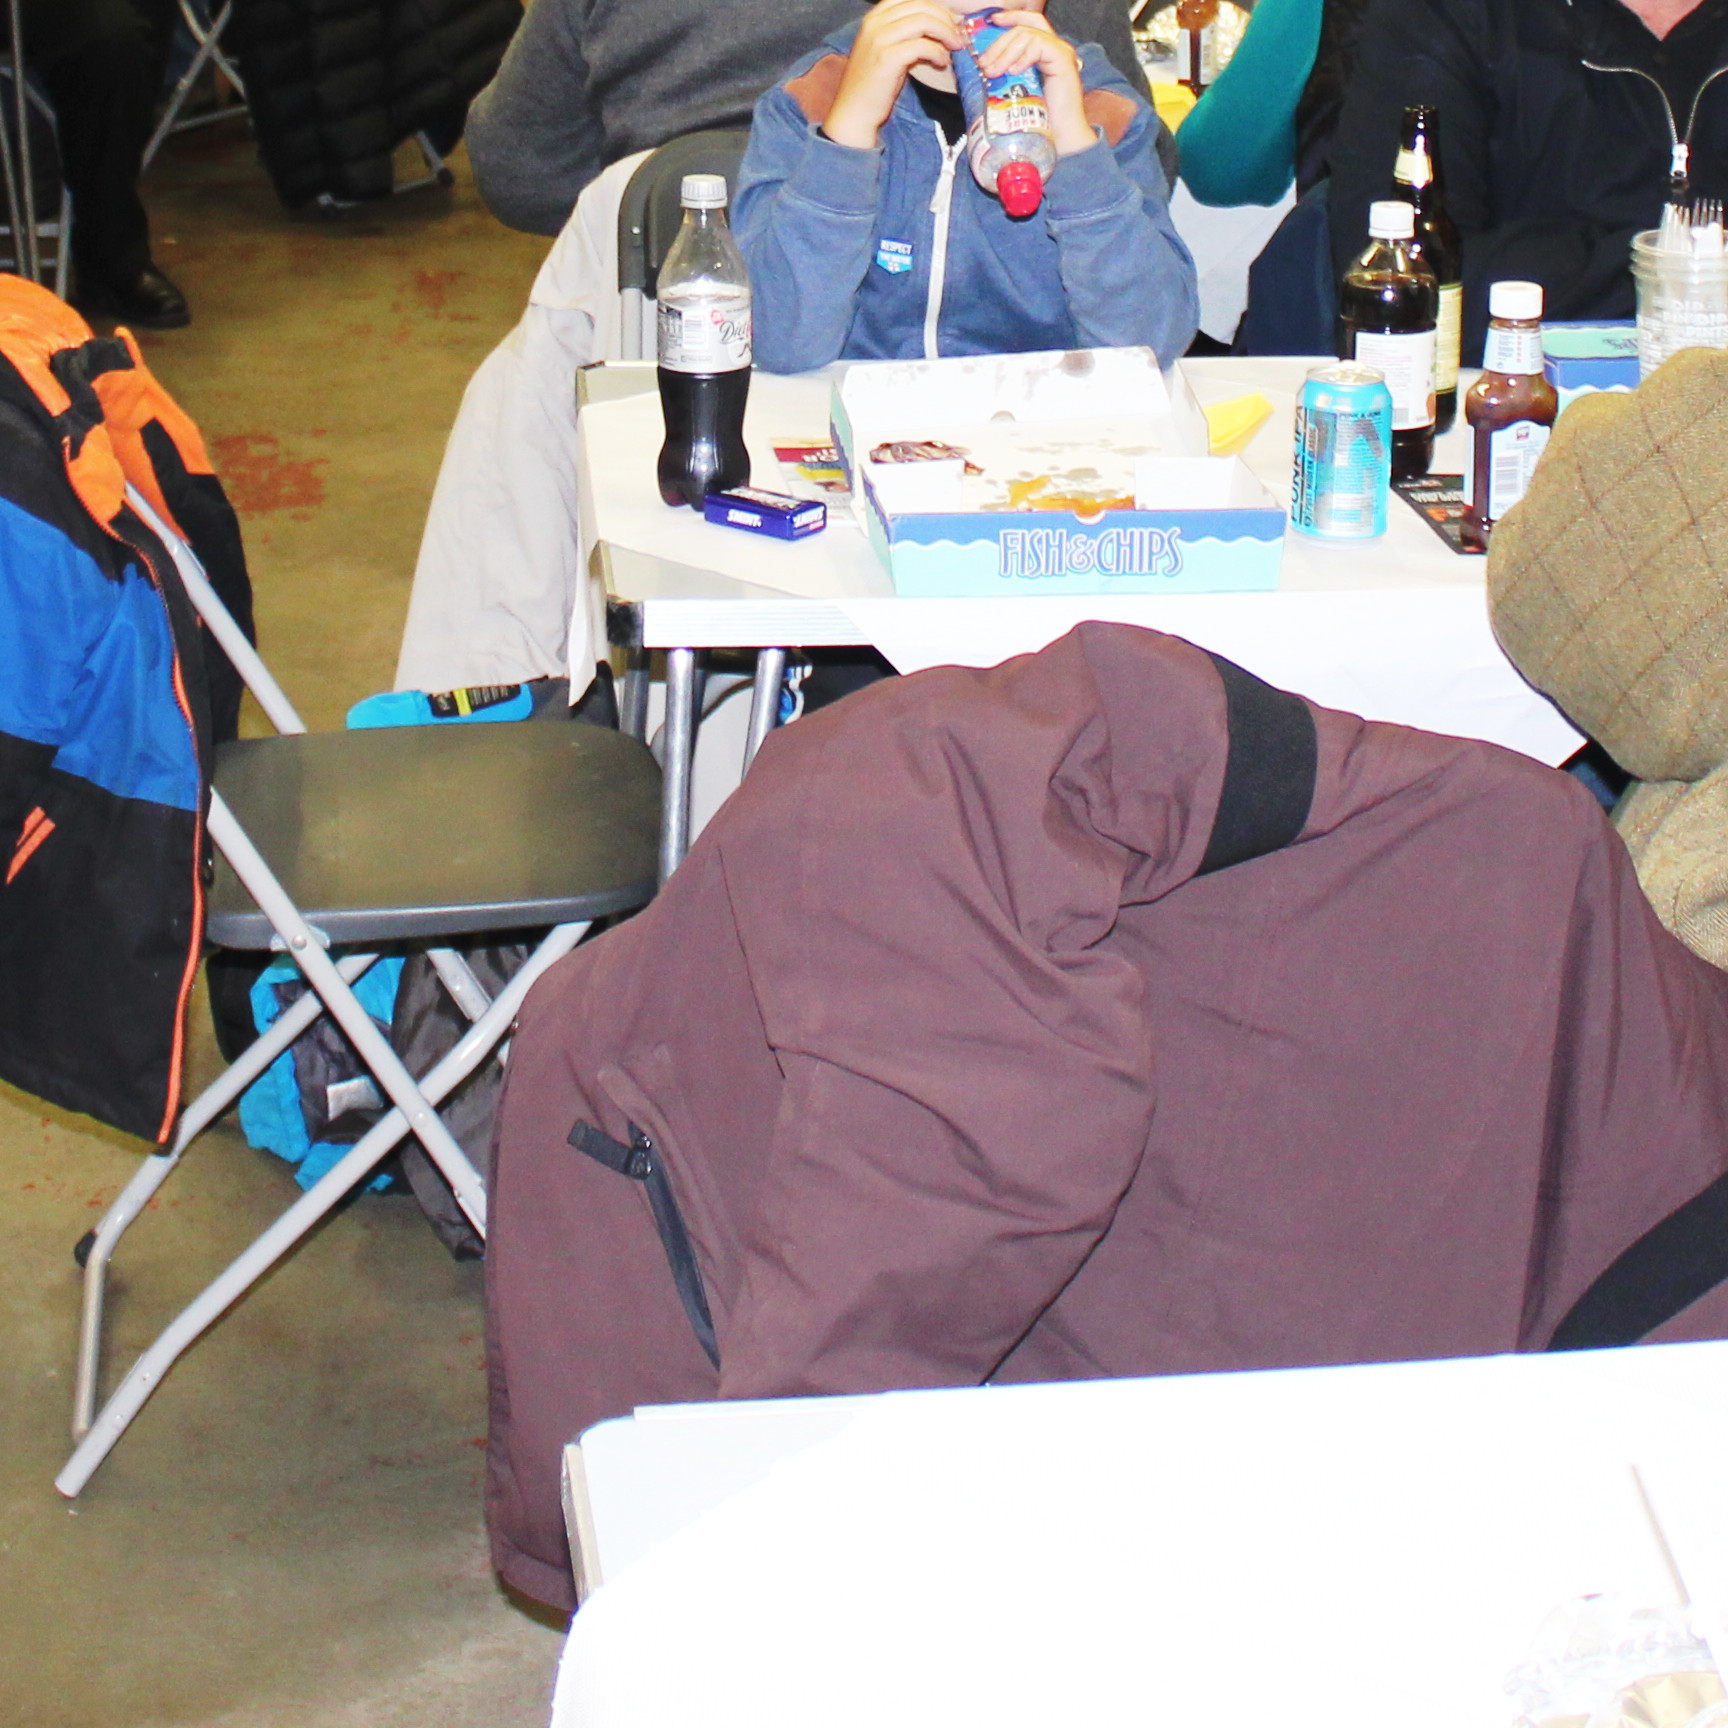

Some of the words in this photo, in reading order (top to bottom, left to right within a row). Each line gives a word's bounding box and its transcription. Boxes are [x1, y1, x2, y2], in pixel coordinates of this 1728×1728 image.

[881, 240, 912, 255] RESPECT
[719, 320, 745, 345] Diet
[1294, 405, 1305, 444] IPA
[1290, 453, 1305, 523] PUNK
